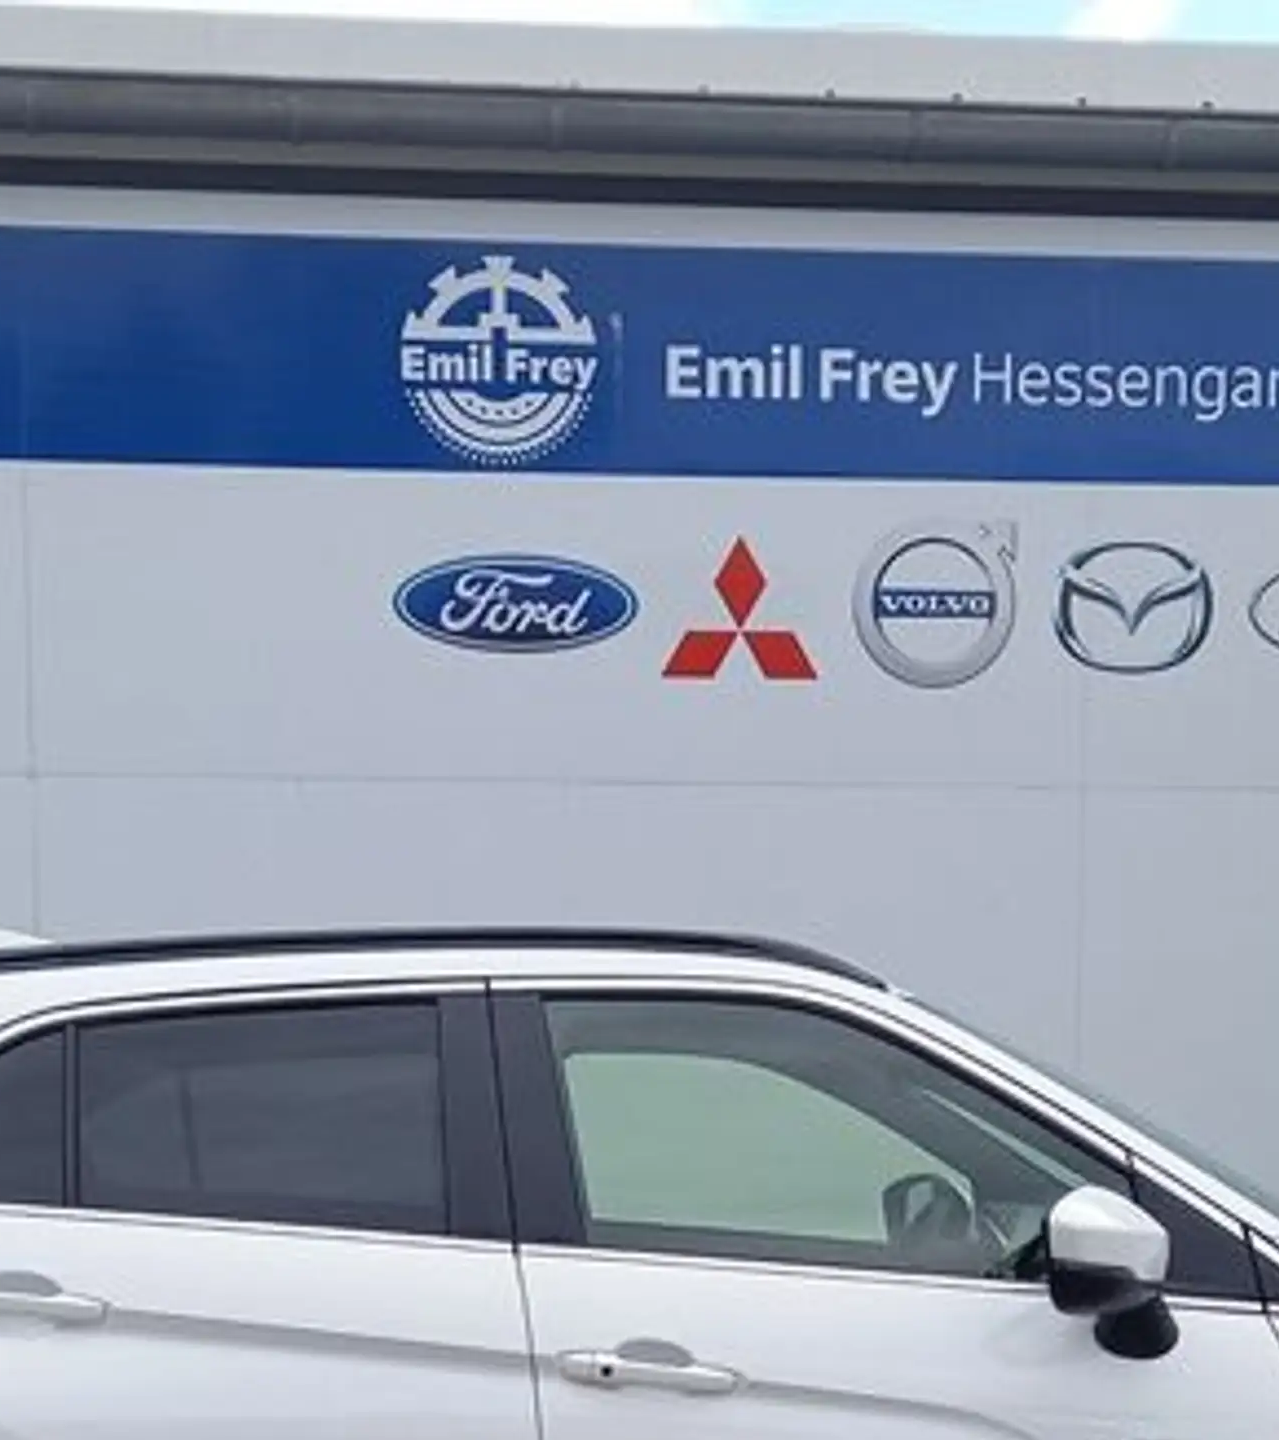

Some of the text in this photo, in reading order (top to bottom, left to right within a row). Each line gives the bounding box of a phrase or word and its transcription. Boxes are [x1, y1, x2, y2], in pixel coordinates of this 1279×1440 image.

[401, 344, 599, 391] Emil Frey
[665, 343, 804, 399] Emil
[819, 347, 959, 418] Frey
[438, 567, 590, 638] Ford
[881, 594, 990, 614] VOLVO
